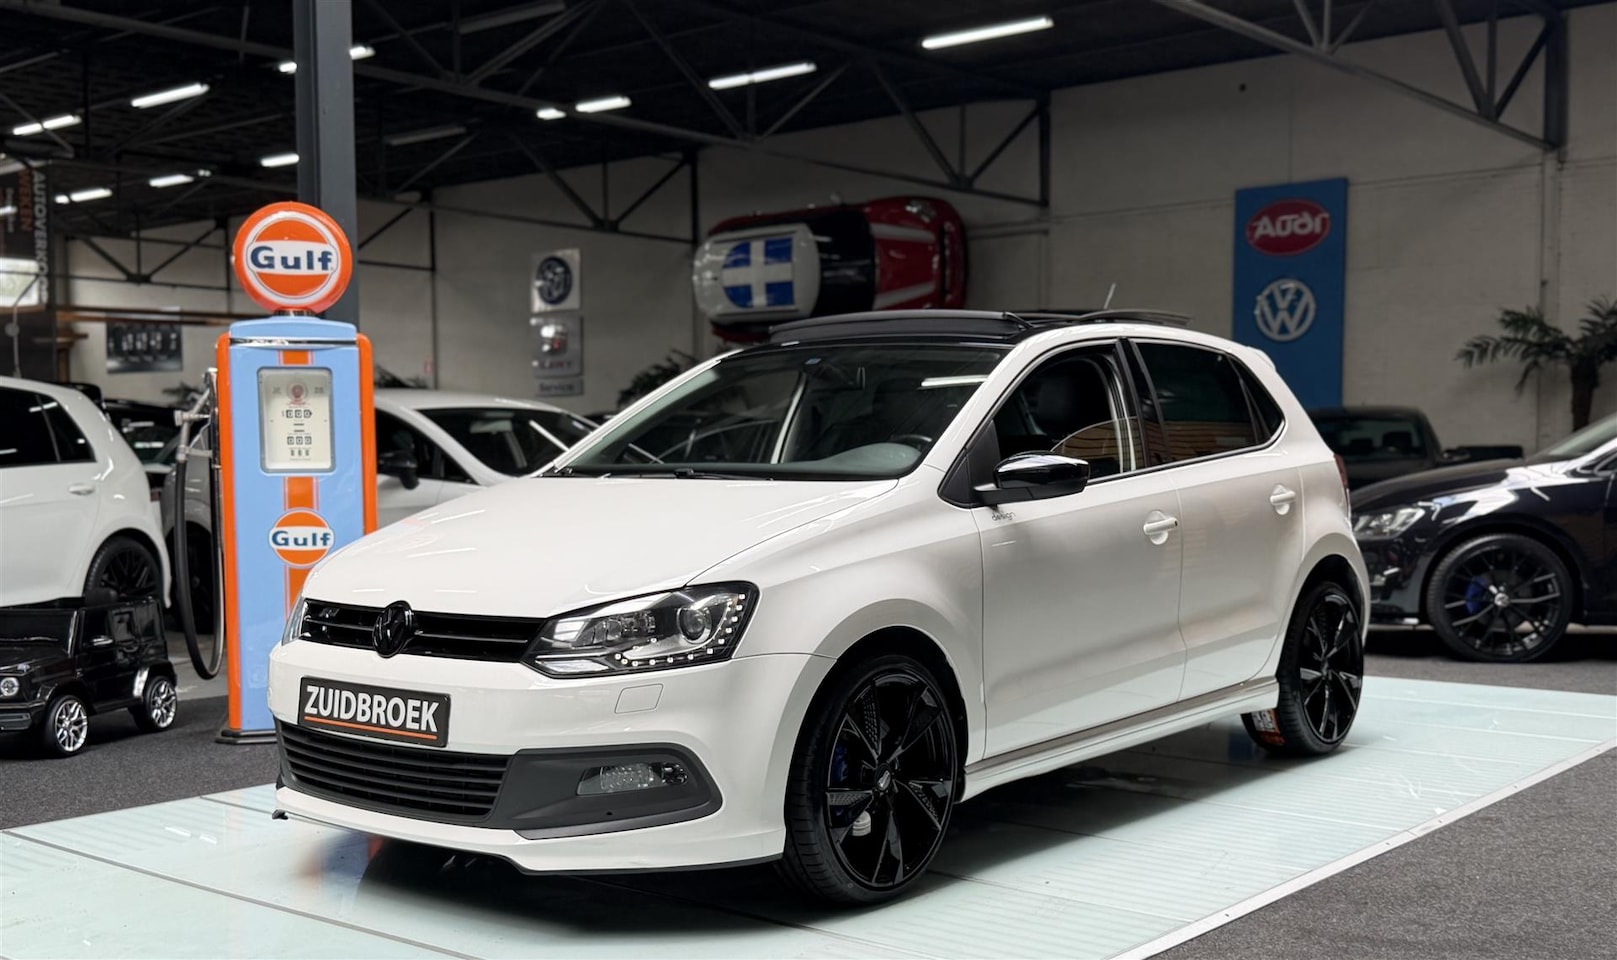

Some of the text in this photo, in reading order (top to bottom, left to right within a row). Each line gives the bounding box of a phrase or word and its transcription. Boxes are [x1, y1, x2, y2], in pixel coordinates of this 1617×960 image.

[250, 245, 333, 271] Gulf
[271, 530, 331, 546] Gulf
[304, 685, 439, 733] ZUIDBROEK
